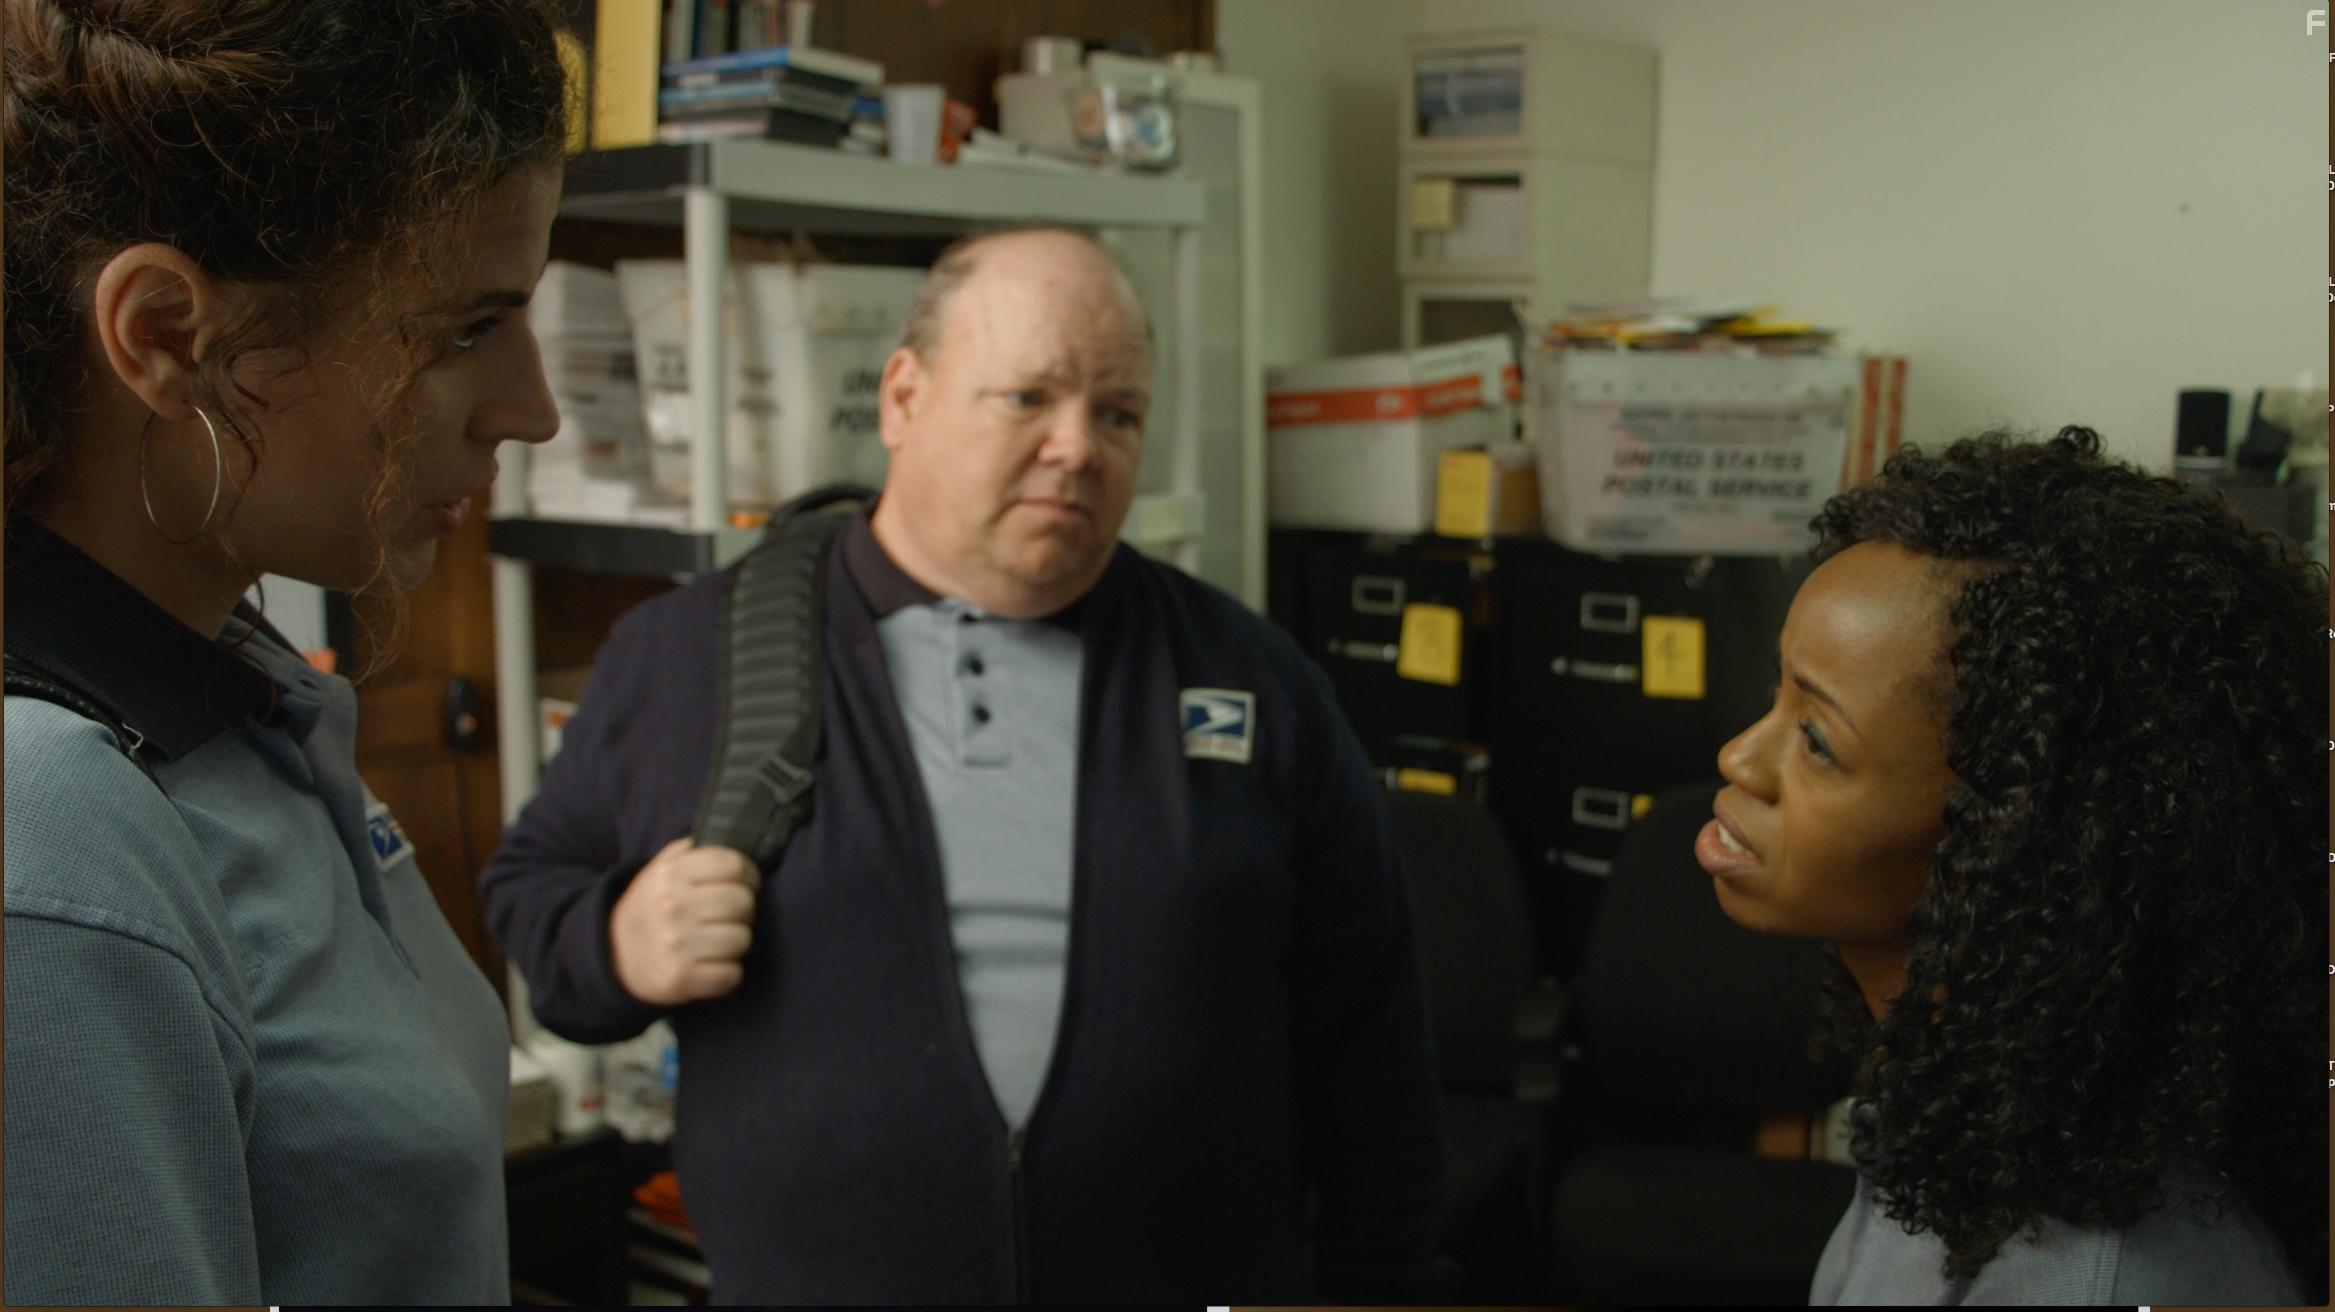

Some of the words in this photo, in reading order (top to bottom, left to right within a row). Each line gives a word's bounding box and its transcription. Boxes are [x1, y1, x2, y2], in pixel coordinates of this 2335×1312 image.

[1613, 449, 1704, 470] UNITED
[1711, 450, 1805, 471] STATES
[1602, 475, 1698, 496] POSTAL
[1708, 477, 1812, 498] SERVICE
